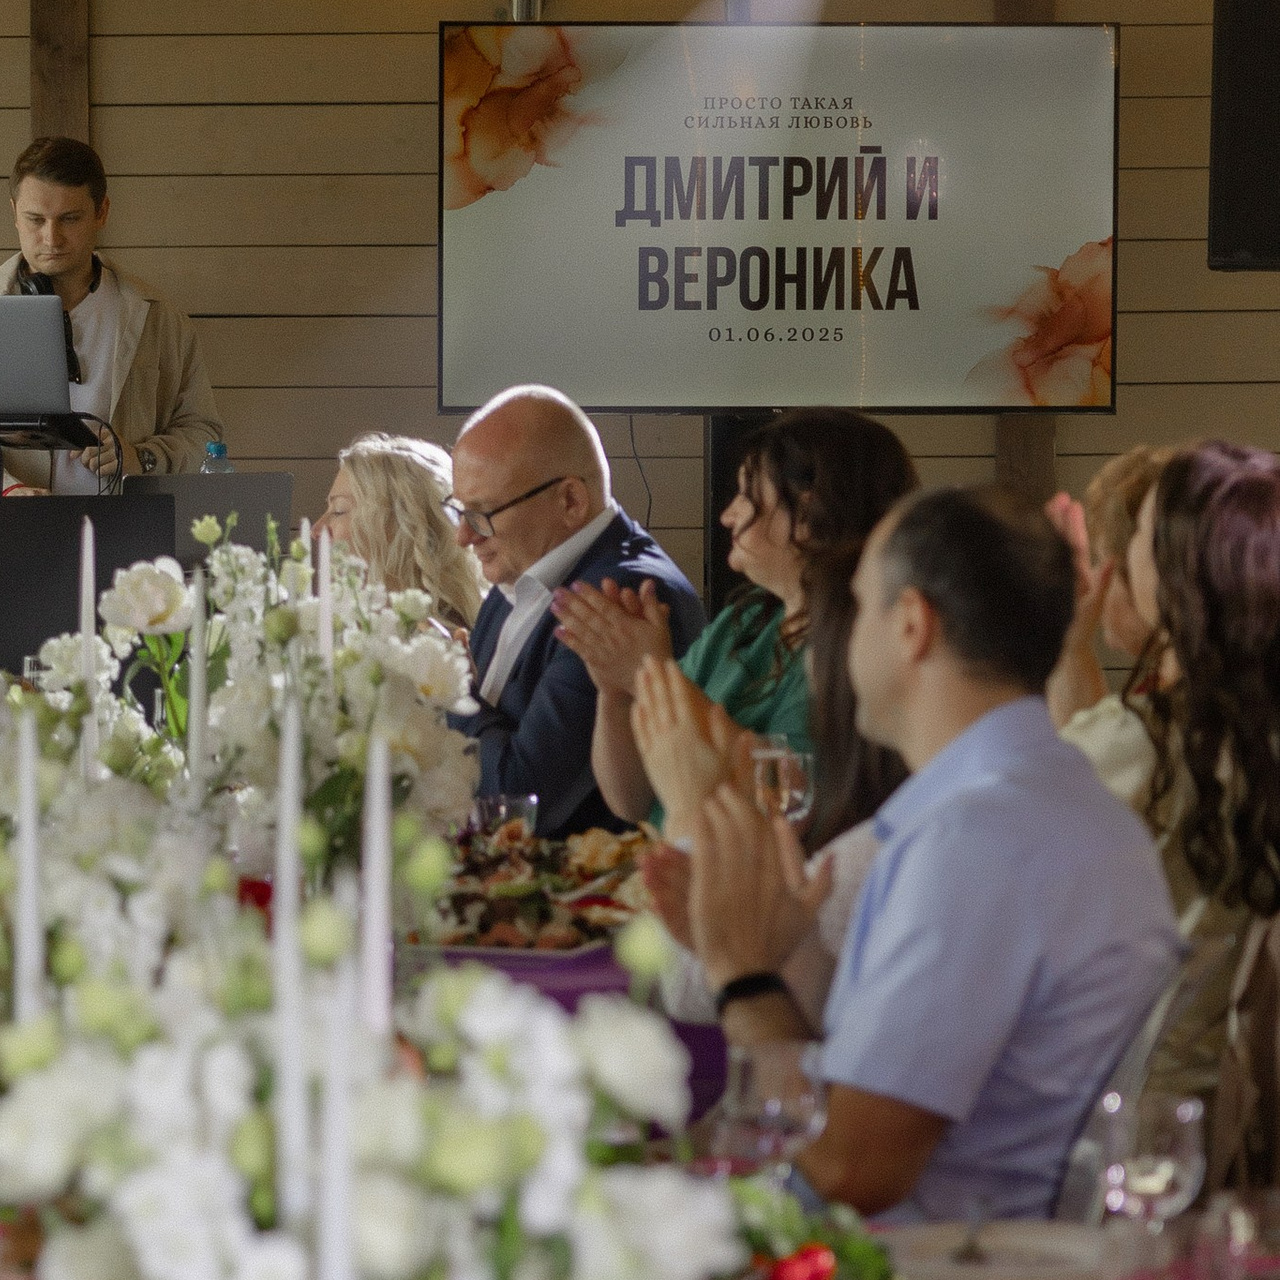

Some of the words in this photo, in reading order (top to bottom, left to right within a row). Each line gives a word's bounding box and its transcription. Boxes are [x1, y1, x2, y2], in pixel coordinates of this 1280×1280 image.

[703, 96, 783, 110] ПРОСТО
[790, 96, 853, 110] ТАКАЯ
[683, 115, 780, 129] СИЛЬНАЯ
[788, 115, 873, 129] ЛЮБОВЬ
[615, 145, 887, 227] ДМИТРИЙ
[906, 156, 939, 220] И
[638, 246, 920, 311] ВЕРОНИКА
[708, 327, 844, 342] 01.06.2025
